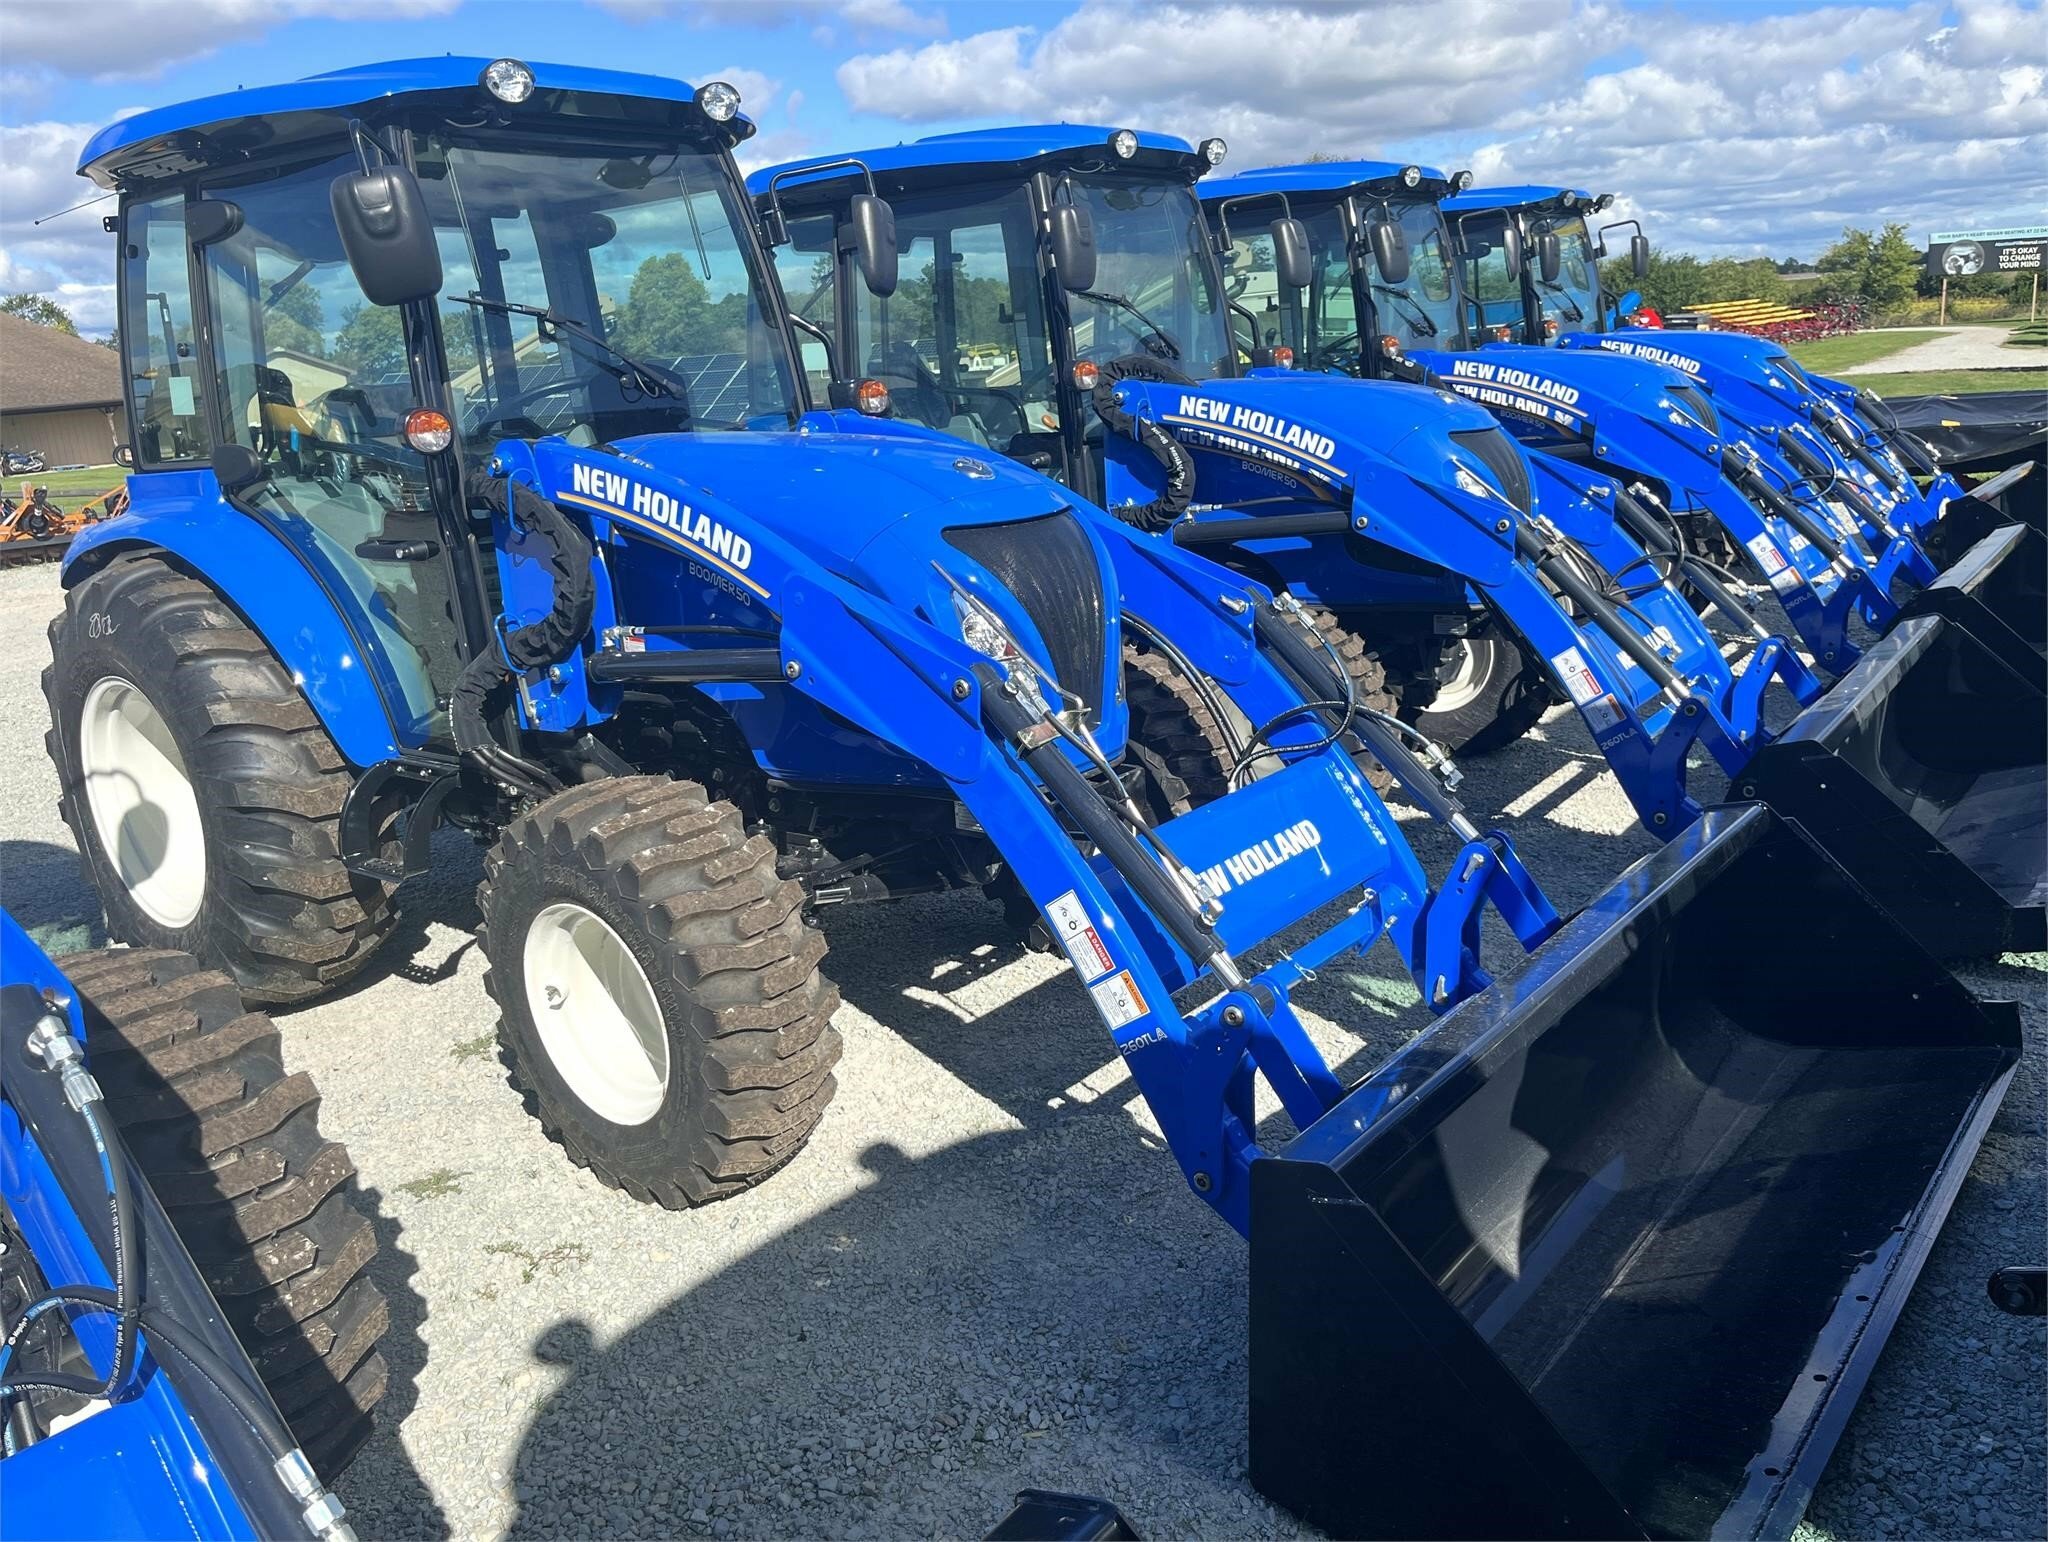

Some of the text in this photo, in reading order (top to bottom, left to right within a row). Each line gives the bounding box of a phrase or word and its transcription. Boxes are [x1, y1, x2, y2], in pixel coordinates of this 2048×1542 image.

[1998, 260, 2040, 269] YOUR MIND
[2010, 253, 2041, 262] CHANGE
[2017, 247, 2039, 255] OKAY
[1634, 344, 1701, 374] HOLLAND
[1453, 360, 1579, 405] NEW HOLLAND
[1179, 395, 1335, 460] NEW HOLLAND
[573, 463, 752, 570] NEW HOLLAND
[1223, 819, 1322, 886] HOLLAND
[1091, 938, 1111, 968] DANGER
[1119, 1026, 1168, 1056] 260TLA
[115, 1249, 123, 1284] Resistant
